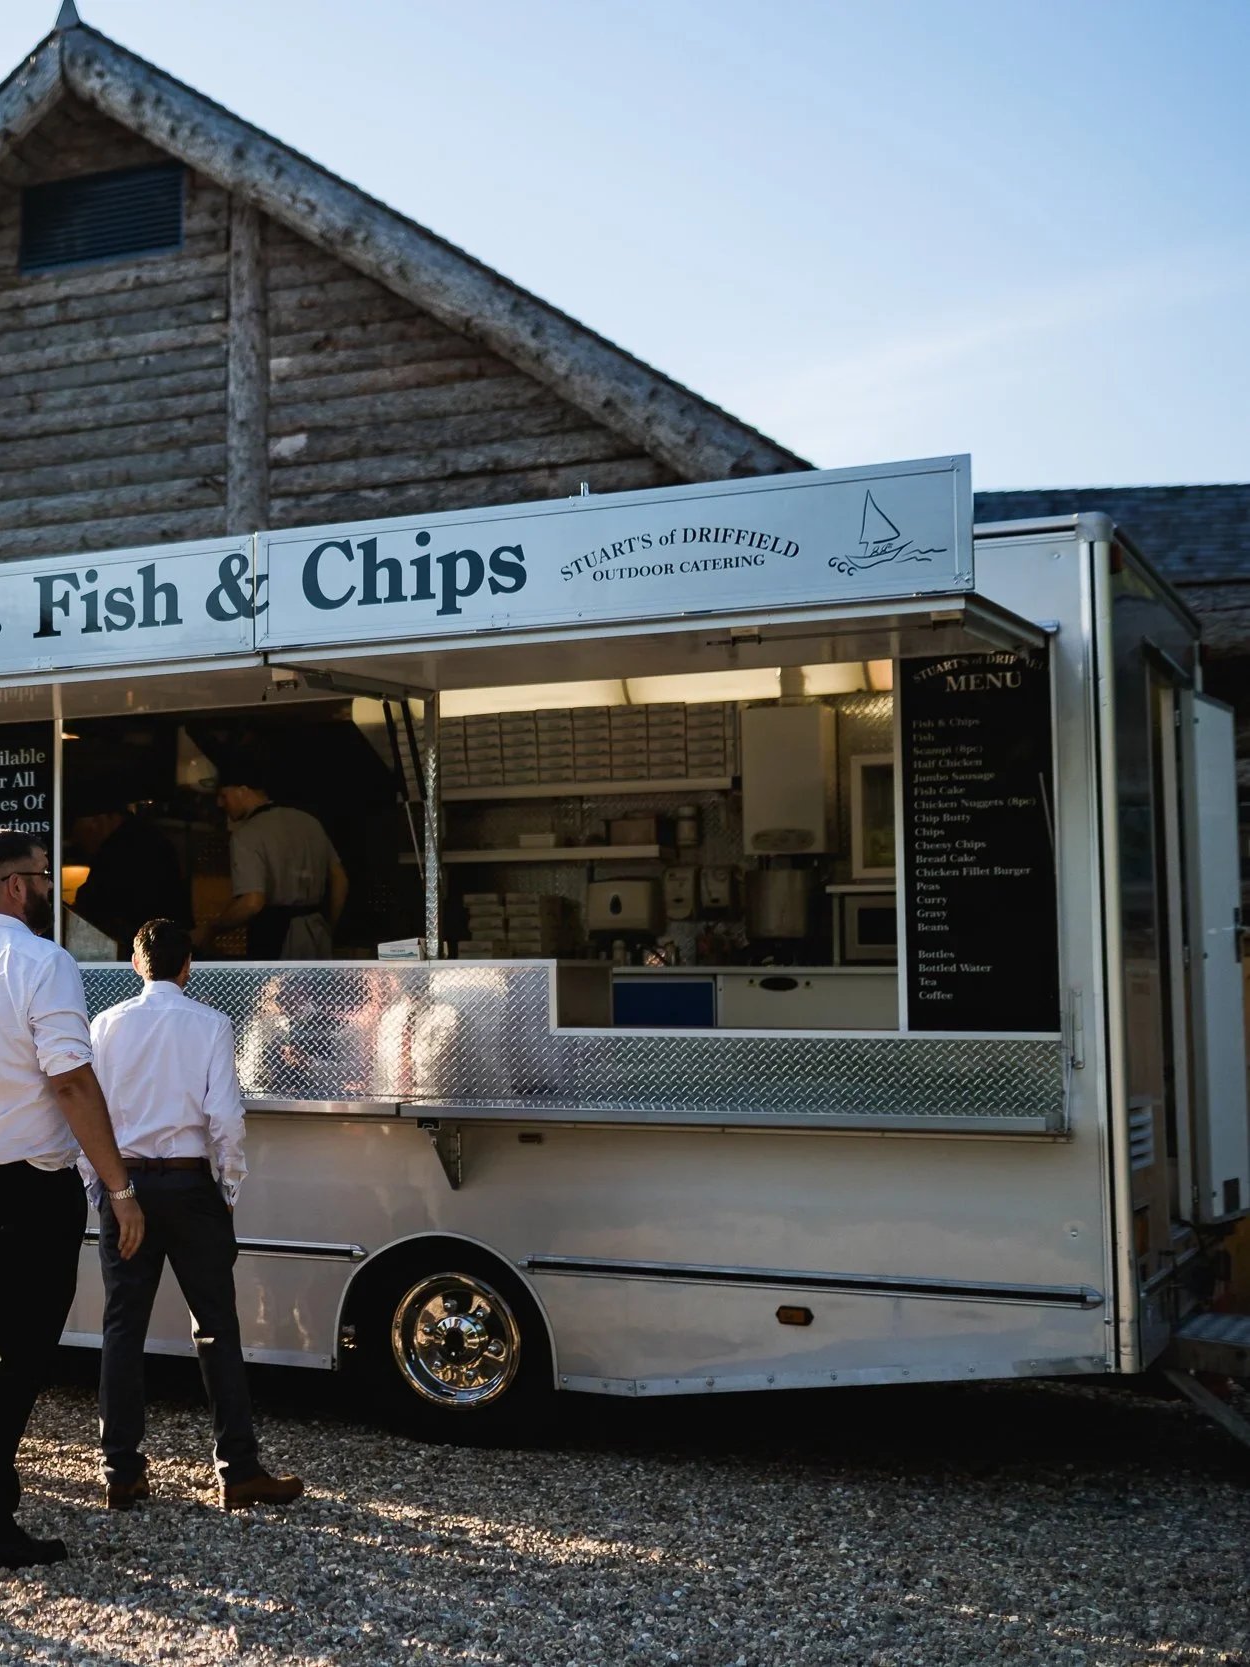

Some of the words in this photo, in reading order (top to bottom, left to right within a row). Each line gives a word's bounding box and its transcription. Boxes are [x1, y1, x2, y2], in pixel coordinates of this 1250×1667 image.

[559, 533, 653, 582] STUART'S
[658, 529, 677, 546] of
[682, 527, 800, 559] DRIFFIELD
[592, 563, 675, 582] OUTDOOR
[679, 553, 766, 574] CATERING
[32, 562, 183, 638] Fish
[205, 553, 270, 622] &
[302, 530, 528, 616] Chips
[945, 671, 1023, 692] MENU
[911, 720, 935, 729] Fish
[949, 717, 981, 728] Chips
[912, 732, 935, 742] Fish
[913, 759, 937, 769] Half
[938, 757, 983, 768] Chicken
[12, 771, 35, 788] All
[913, 773, 949, 783] Jumbo
[951, 771, 996, 781] Sausage
[913, 786, 937, 797] Fish
[939, 785, 966, 795] Cake
[23, 793, 46, 810] Of
[914, 799, 958, 809] Chicken
[960, 798, 1004, 809] Nuggets
[914, 813, 941, 824] Chip
[942, 812, 972, 823] Butty
[914, 827, 946, 838] Chips
[915, 841, 952, 851] Cheesy
[955, 839, 987, 850] Chips
[915, 854, 947, 864] Bread
[949, 853, 977, 863] Cake
[915, 867, 960, 877] Chicken
[962, 866, 991, 876] Fillet
[993, 866, 1032, 877] Burger
[916, 881, 941, 891] Peas
[916, 895, 949, 906] Curry
[916, 908, 948, 920] Gravy
[917, 922, 950, 932] Beans
[918, 949, 956, 960] Bottles
[918, 963, 957, 973] Bottled
[959, 963, 993, 973] Water
[919, 977, 938, 987] Tea
[918, 990, 954, 1001] Coffee
